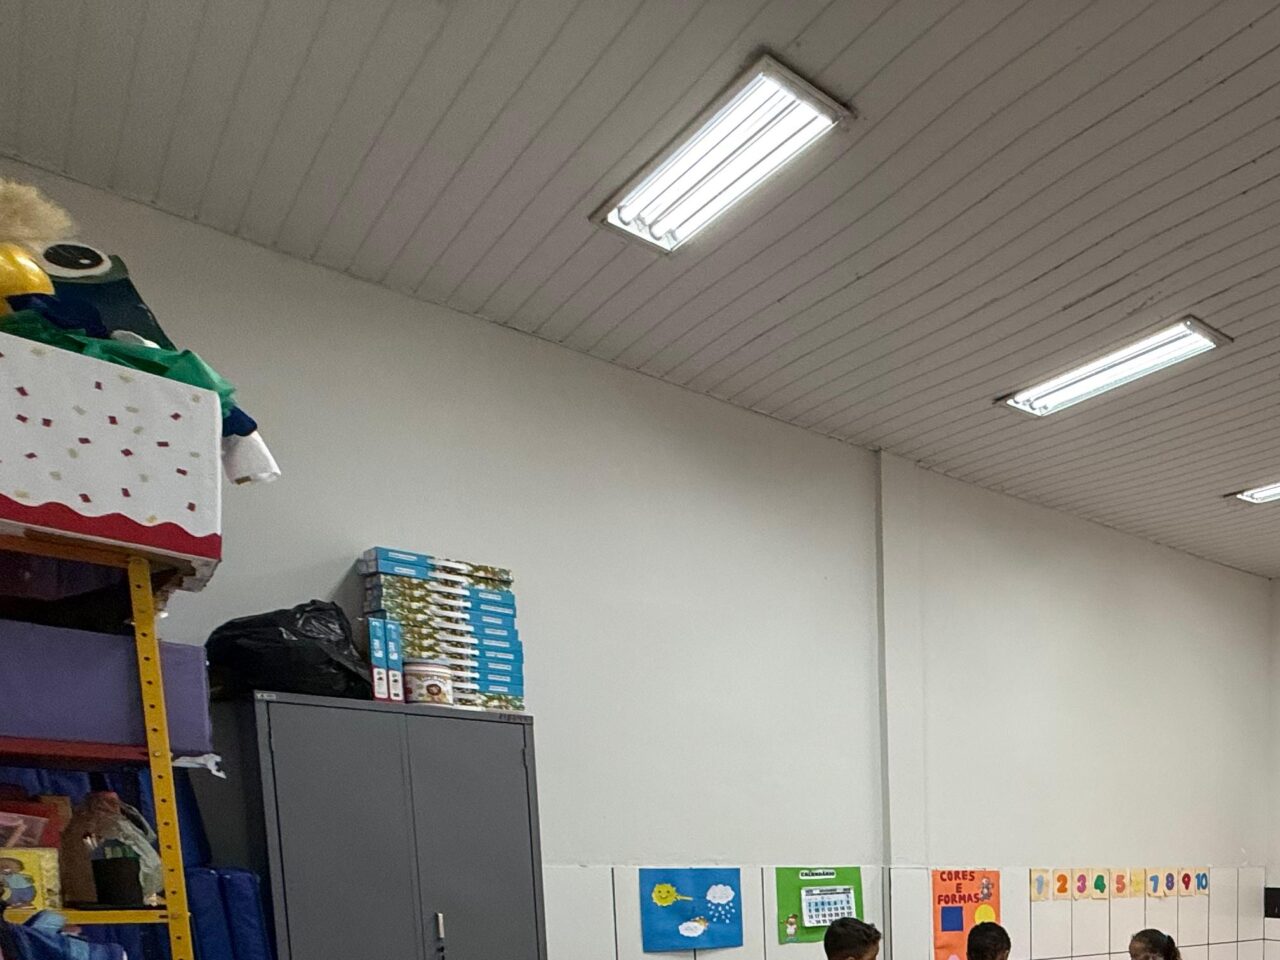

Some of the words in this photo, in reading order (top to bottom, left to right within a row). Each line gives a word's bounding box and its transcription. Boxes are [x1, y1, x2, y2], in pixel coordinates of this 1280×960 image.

[940, 870, 975, 882] CORES
[956, 883, 962, 893] E
[1036, 874, 1044, 894] 1
[1056, 874, 1068, 893] 2
[1076, 874, 1086, 893] 3
[1094, 874, 1106, 893] 4
[1116, 874, 1125, 893] 5
[1150, 875, 1159, 892] 7
[1166, 873, 1175, 890] 8
[1182, 873, 1191, 890] 9
[1195, 872, 1208, 890] 10
[938, 893, 980, 904] FORMAS
